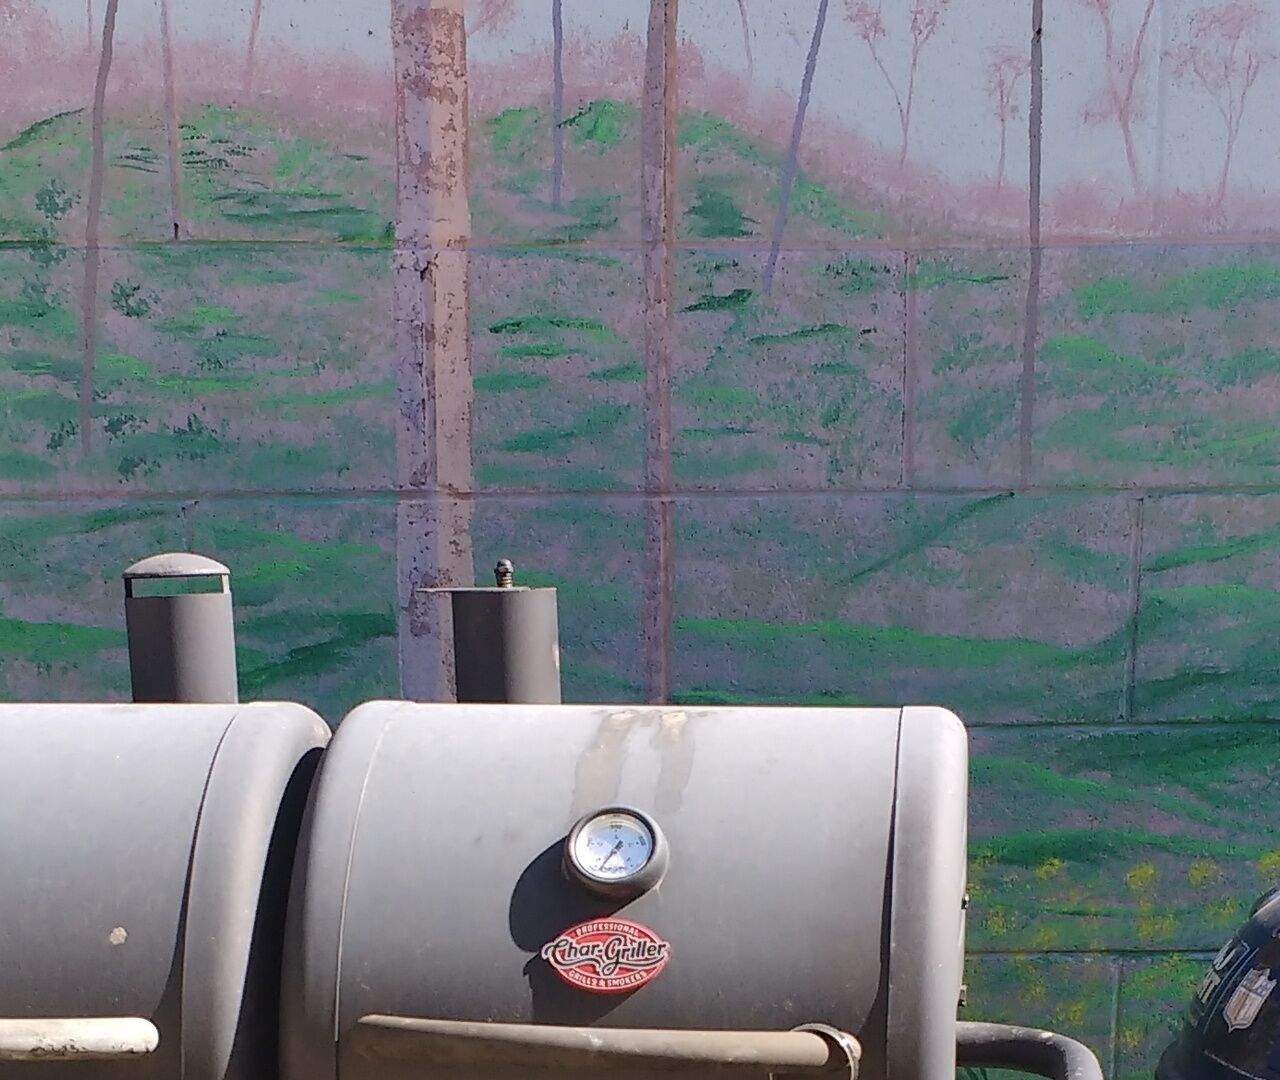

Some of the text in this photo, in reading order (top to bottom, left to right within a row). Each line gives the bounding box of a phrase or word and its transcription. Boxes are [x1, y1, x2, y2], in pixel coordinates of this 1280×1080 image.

[575, 922, 639, 936] PROFESSIONAL
[543, 935, 668, 977] Char-Griller
[568, 968, 598, 986] GRILLS
[607, 971, 648, 987] SMOKERS
